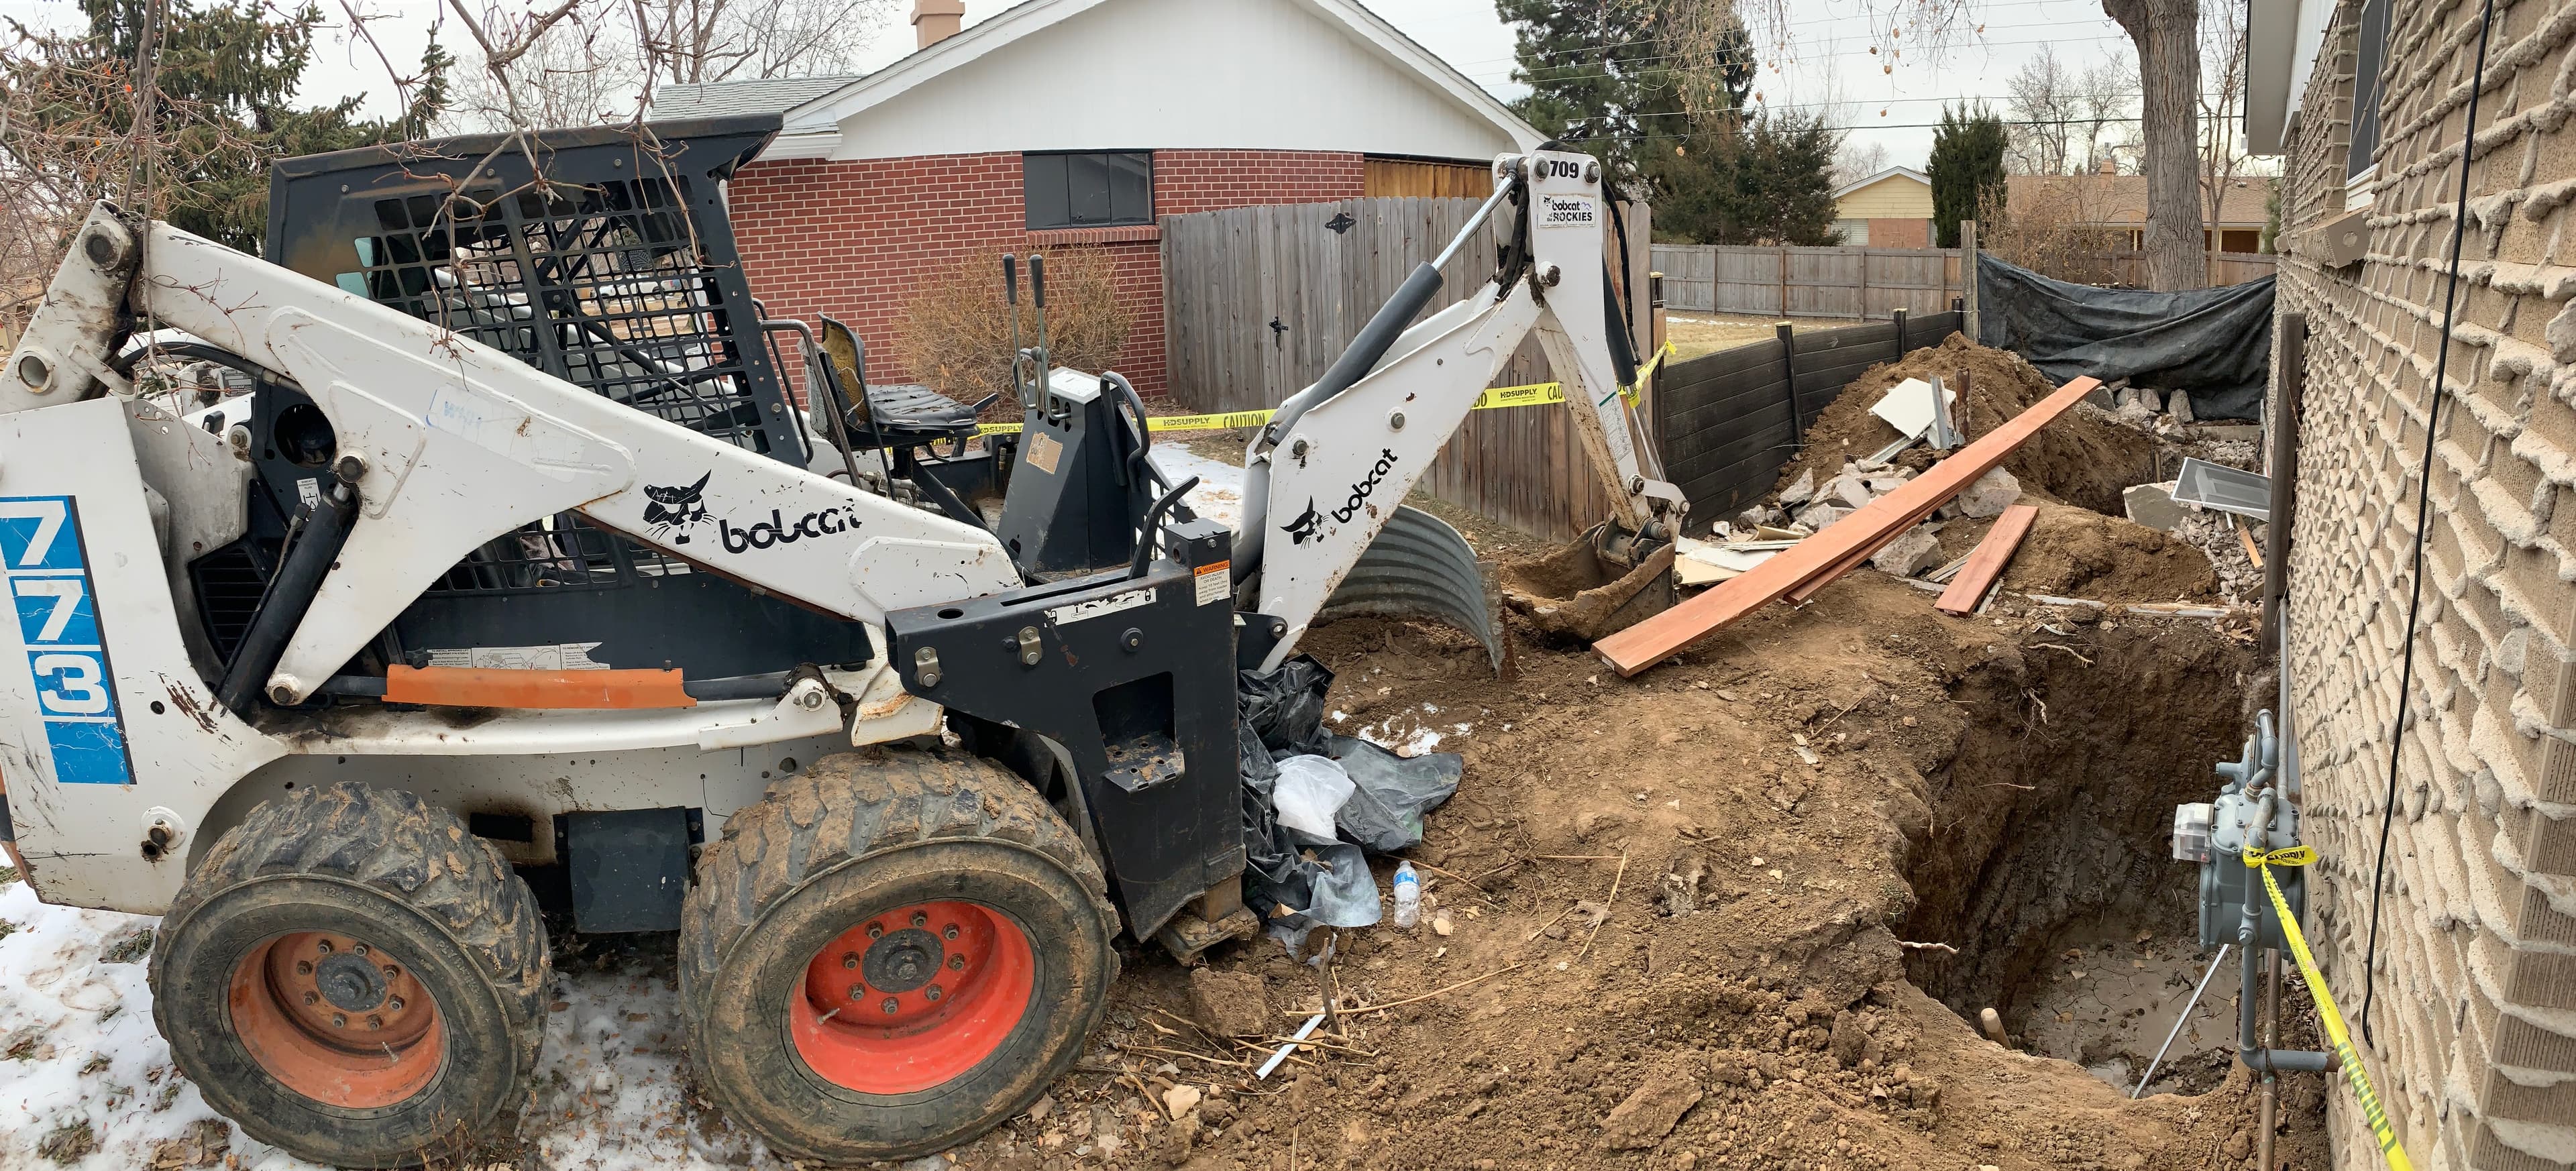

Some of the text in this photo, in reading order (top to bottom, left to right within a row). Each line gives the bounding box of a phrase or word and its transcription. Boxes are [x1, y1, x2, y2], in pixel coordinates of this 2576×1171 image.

[1550, 160, 1579, 178] 709
[1552, 199, 1580, 211] bobcat
[1553, 212, 1593, 222] ROCKIES
[1223, 412, 1266, 428] CAUTION
[1330, 447, 1399, 524] bobcat
[1203, 562, 1228, 573] WARNING
[0, 500, 108, 714] 773
